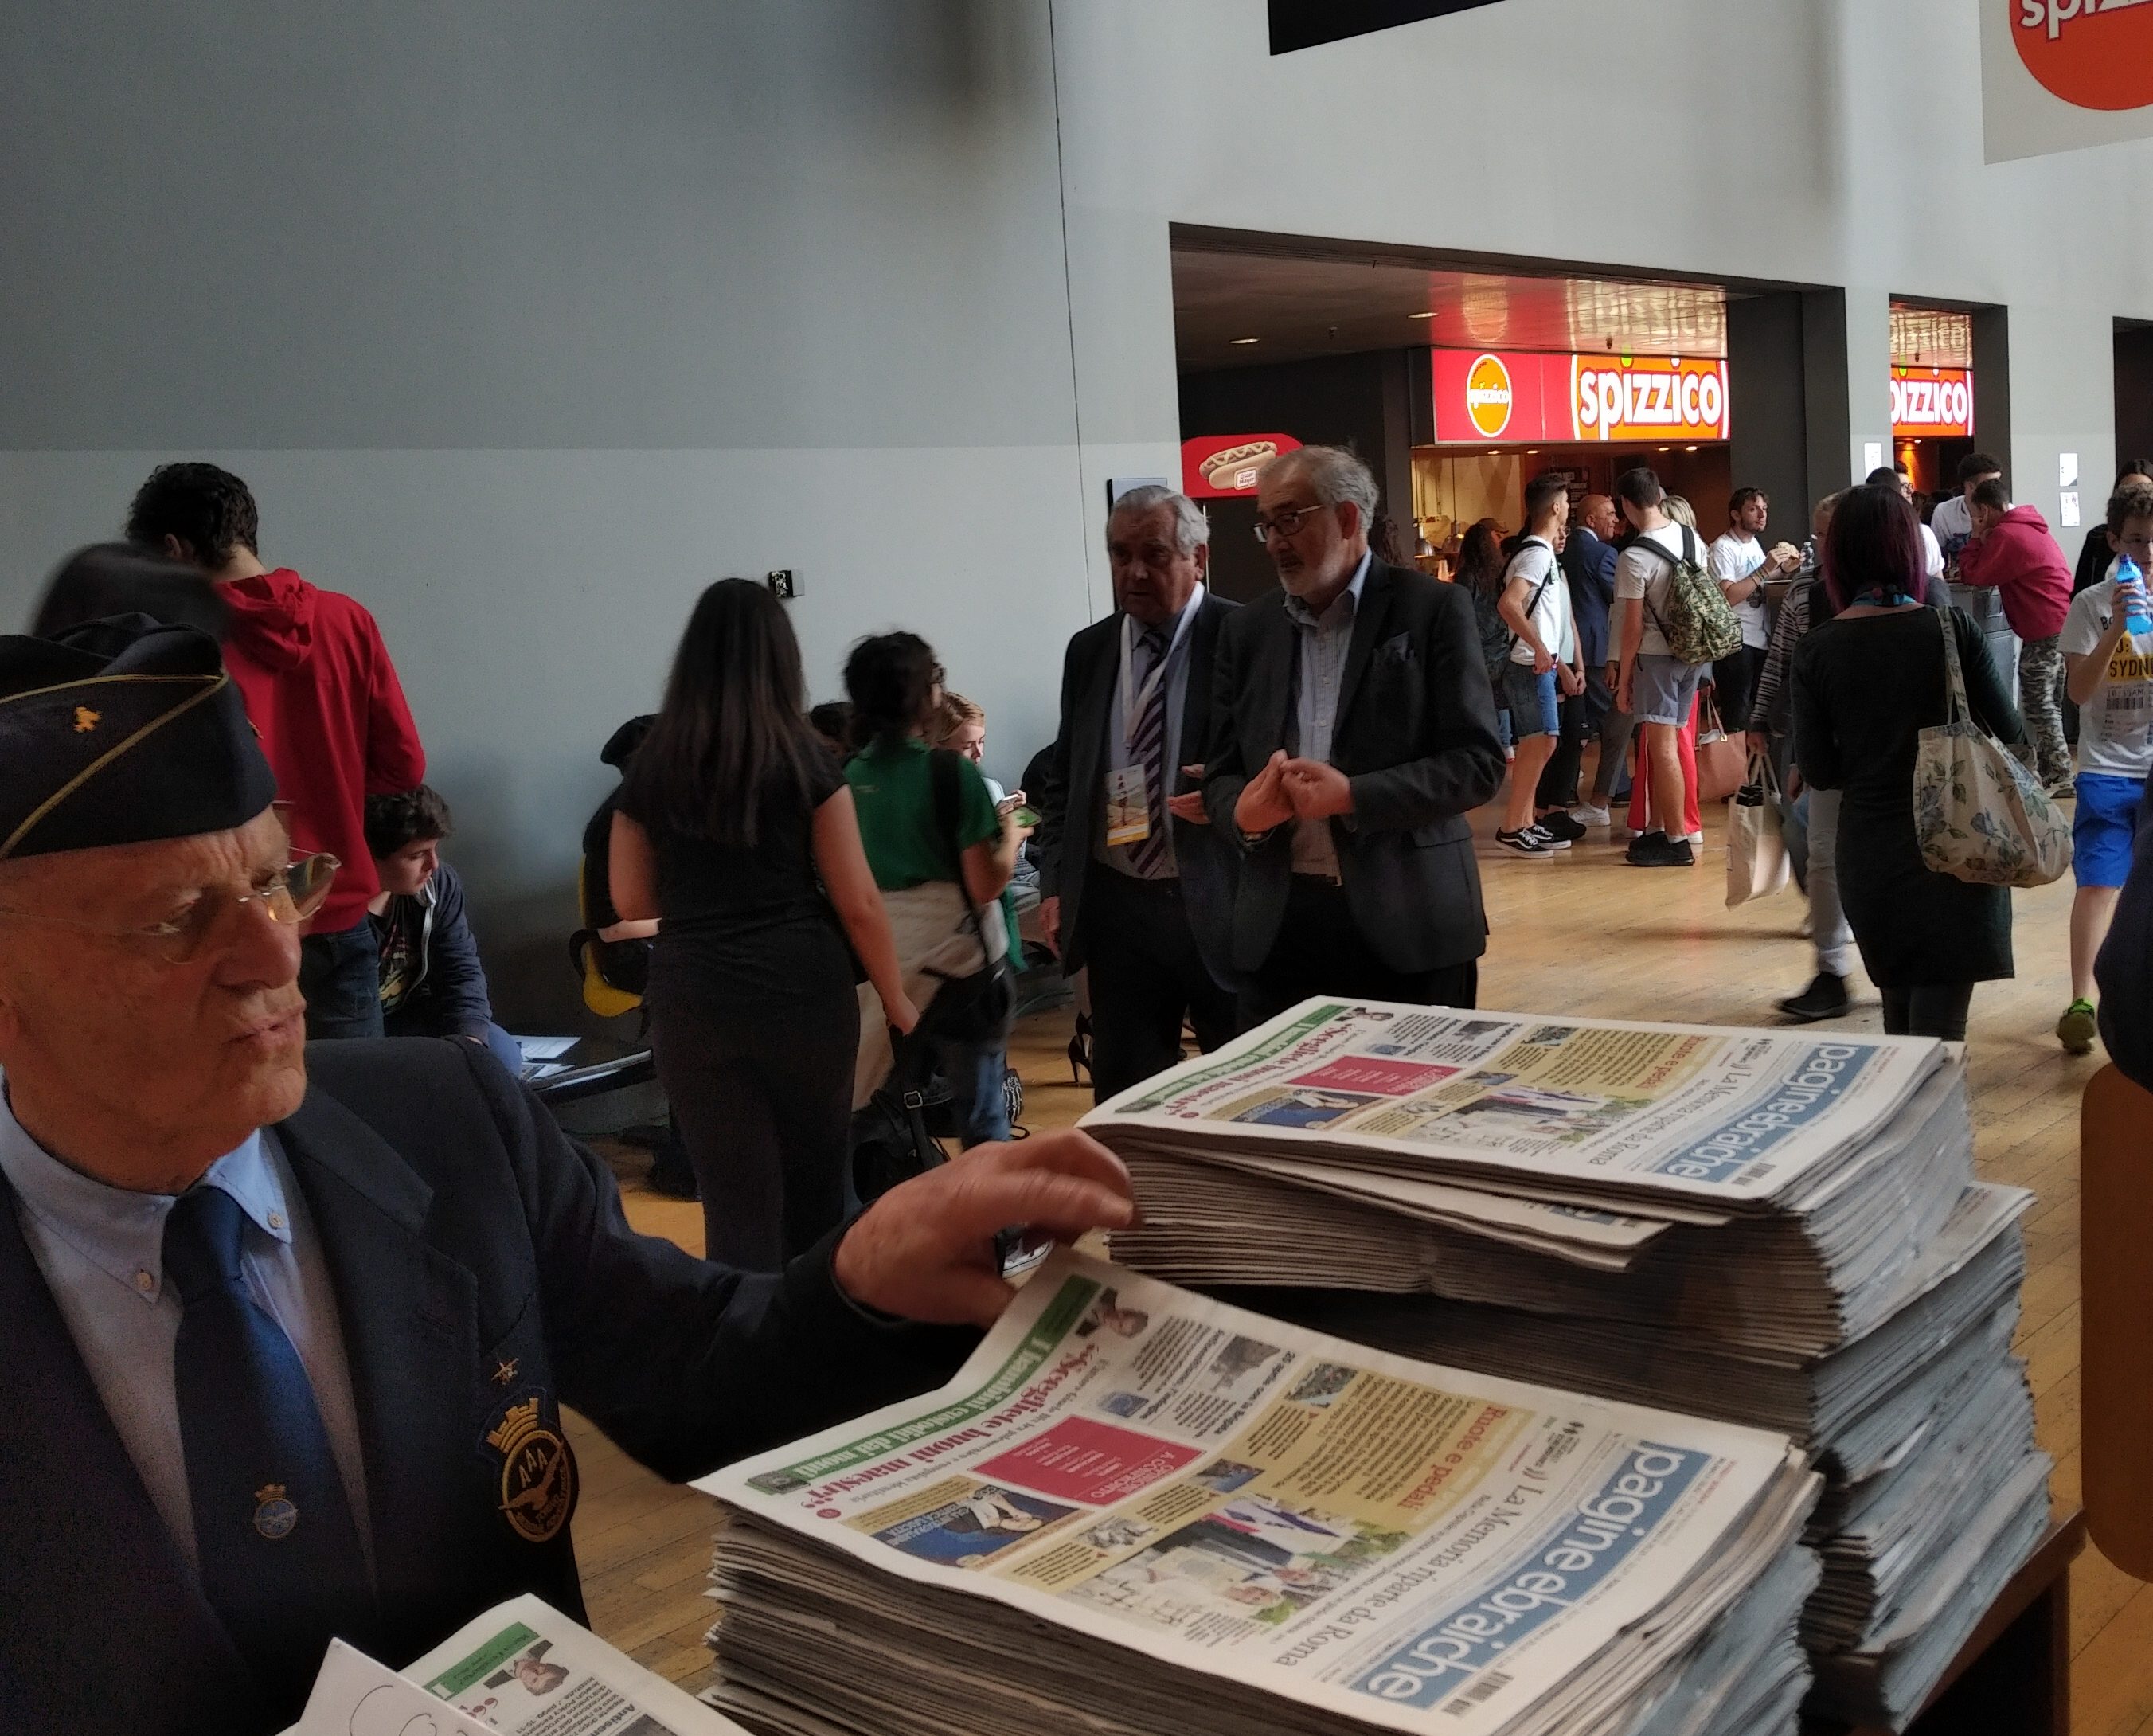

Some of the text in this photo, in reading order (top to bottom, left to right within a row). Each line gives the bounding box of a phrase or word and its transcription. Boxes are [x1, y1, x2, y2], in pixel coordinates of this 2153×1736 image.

[1579, 356, 1722, 440] spizzico
[1668, 1045, 1858, 1175] pagine ebraiche
[1586, 1142, 1642, 1164] Roma
[963, 1350, 1046, 1410] bambini
[884, 1406, 971, 1442] custoditi
[791, 1451, 859, 1477] monti
[850, 1437, 892, 1456] dai
[906, 1429, 991, 1463] buoni
[1397, 1406, 1508, 1510] Ruote e pedali
[1503, 1486, 1545, 1505] La
[1540, 1444, 1686, 1570] pagine
[1427, 1507, 1522, 1567] Memoria
[1363, 1566, 1435, 1607] riparte
[1334, 1606, 1374, 1625] da
[1370, 1571, 1573, 1697] ebraiche
[1272, 1625, 1354, 1668] Roma
